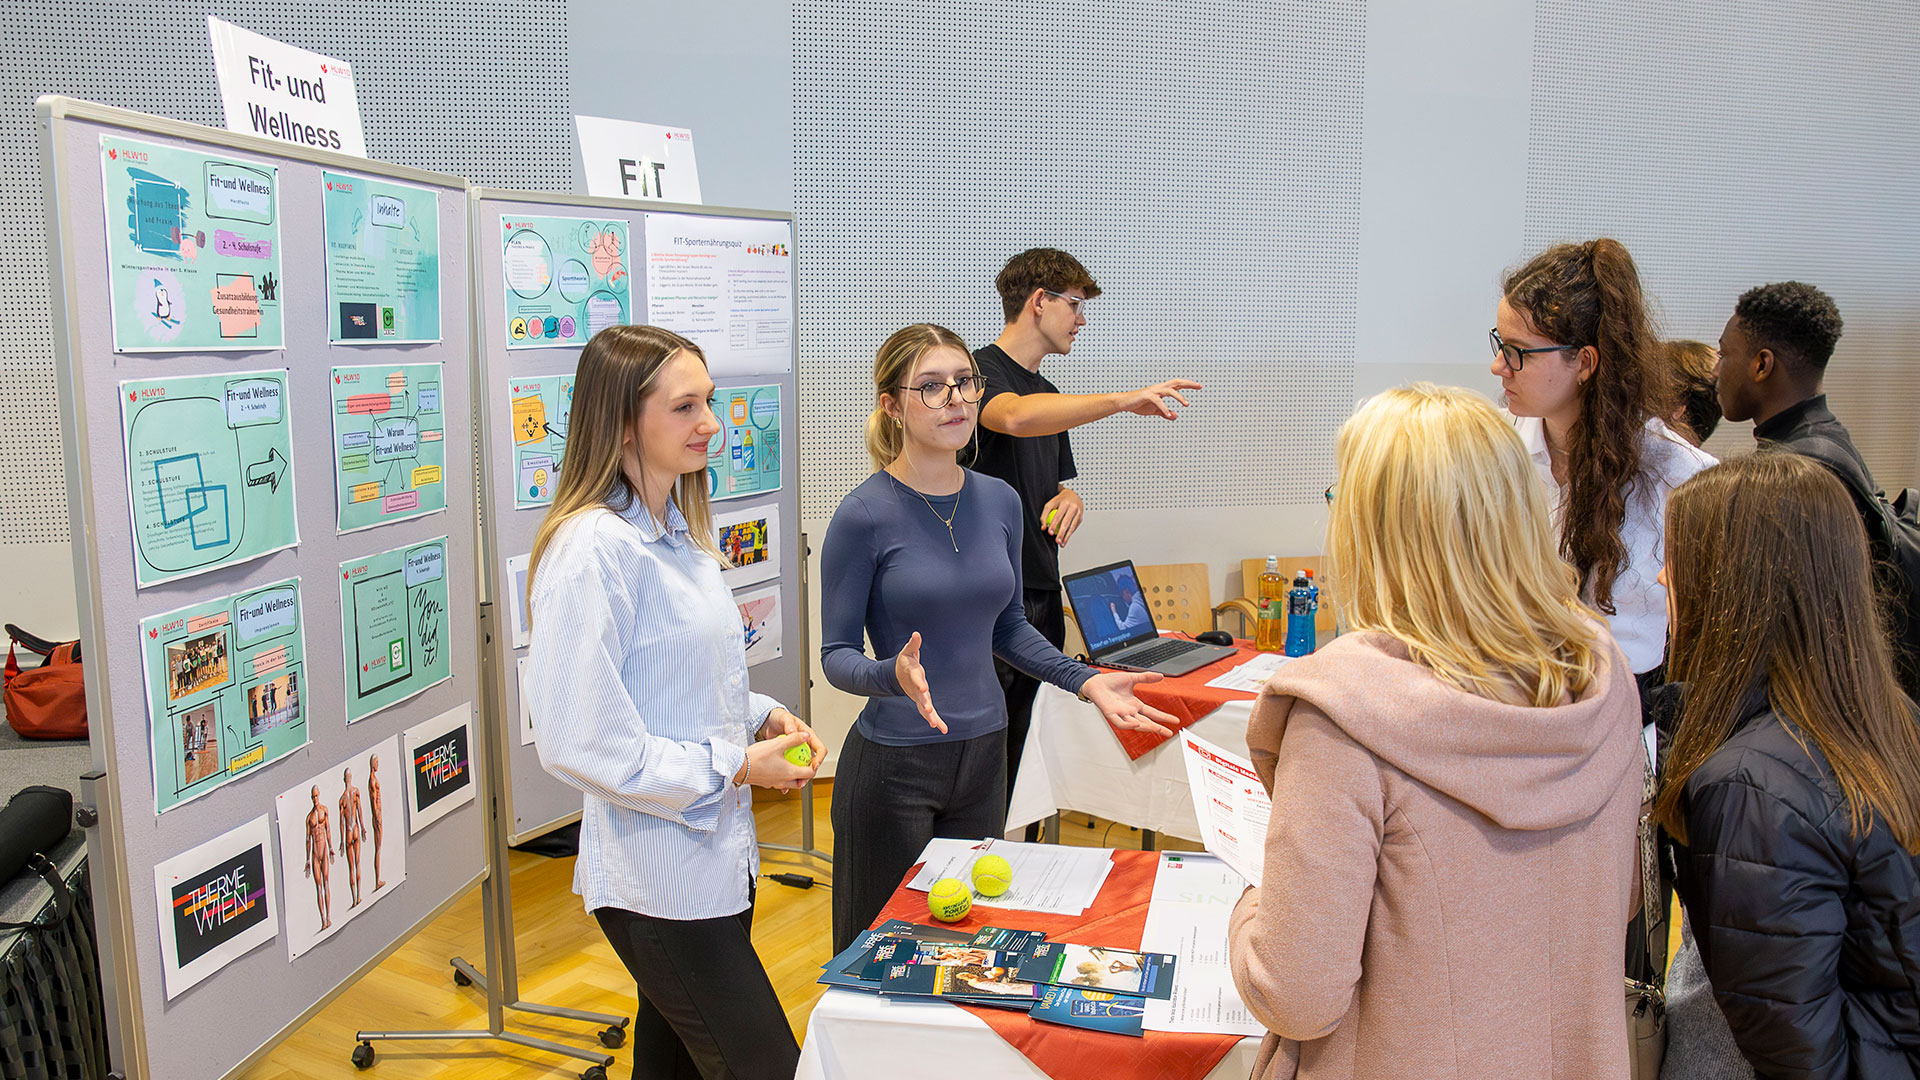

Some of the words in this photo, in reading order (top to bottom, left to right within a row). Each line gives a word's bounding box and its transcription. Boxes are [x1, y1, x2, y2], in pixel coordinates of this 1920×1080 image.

[248, 55, 281, 91] Fit-
[287, 75, 326, 104] und
[248, 102, 341, 150] Wellness
[122, 149, 148, 161] HLW10
[238, 180, 270, 196] Wellness
[336, 183, 352, 192] HLW10
[377, 202, 400, 217] Inhalte
[142, 388, 165, 397] HLW10
[252, 387, 278, 398] Wellness
[386, 428, 404, 438] Warum
[146, 447, 177, 456] SCHULSTUFE
[394, 441, 416, 452] Wellness?
[424, 552, 440, 563] Wellness
[352, 565, 368, 574] HLW10
[265, 597, 294, 615] Wellness
[414, 588, 443, 636] You
[162, 619, 183, 632] HLW10
[421, 619, 438, 647] did
[371, 656, 386, 666] HLW10
[422, 740, 456, 769] THERME
[426, 753, 458, 790] WIEN
[188, 865, 245, 909] THERME
[194, 882, 248, 936] WIEN
[1040, 992, 1056, 1010] VAMED
